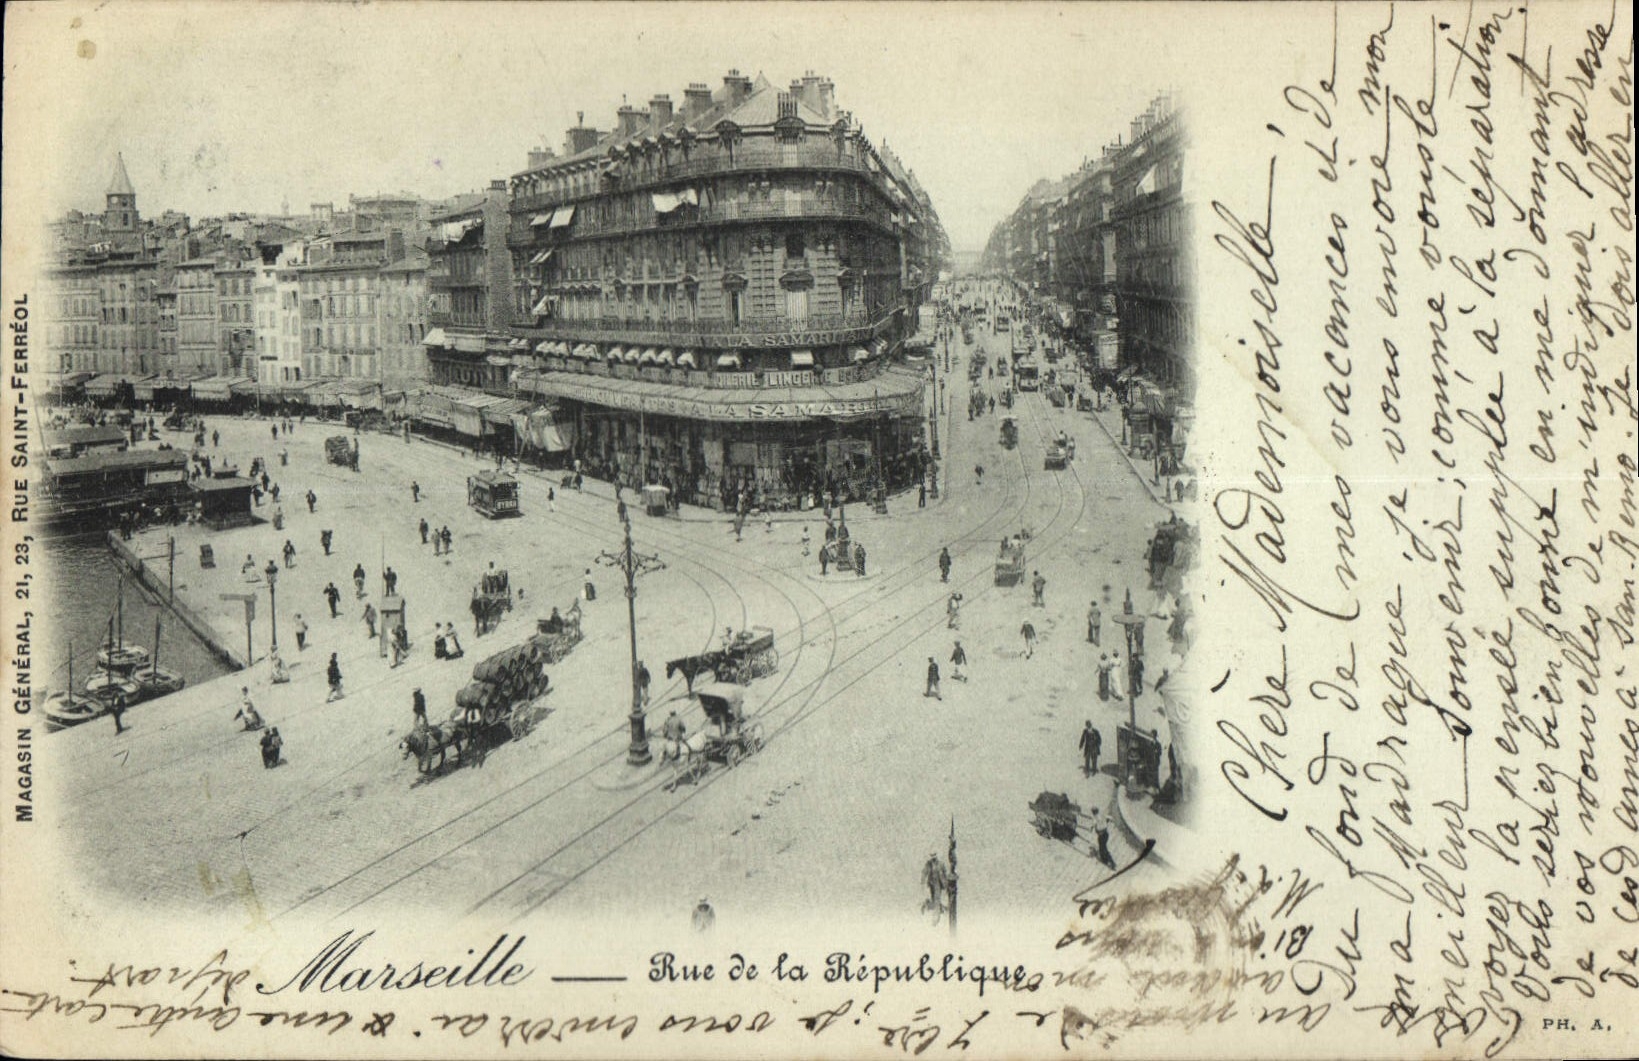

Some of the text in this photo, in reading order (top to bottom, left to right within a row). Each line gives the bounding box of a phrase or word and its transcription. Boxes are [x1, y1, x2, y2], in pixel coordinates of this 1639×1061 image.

[1284, 4, 1337, 128] de
[1358, 2, 1393, 114] mon
[1610, 37, 1634, 105] en
[1304, 136, 1337, 181] et
[1587, 112, 1632, 230] aller
[1349, 85, 1398, 316] envoie
[1449, 248, 1495, 296] la
[1586, 243, 1635, 330] dois
[727, 333, 755, 347] LA
[1323, 212, 1352, 449] vacances
[1458, 303, 1499, 353] à
[1533, 294, 1553, 393] me
[1380, 339, 1406, 462] vous
[1428, 292, 1456, 467] comme
[1530, 410, 1552, 461] en
[1331, 472, 1357, 590] mes
[1383, 487, 1437, 560] je
[1562, 535, 1602, 583] de
[1309, 641, 1359, 710] de
[1518, 661, 1562, 748] bien
[1561, 604, 1600, 833] nouvelles
[1306, 731, 1414, 902] fond
[1468, 820, 1520, 866] la
[1525, 762, 1578, 887] seriez
[1415, 742, 1469, 1010] meilleur
[1574, 849, 1596, 922] vos
[1479, 890, 1528, 1024] voyez
[1552, 950, 1596, 996] de
[1600, 948, 1638, 987] de
[108, 1003, 240, 1036] autre
[658, 1010, 772, 1032] vous
[1257, 1002, 1330, 1031] au
